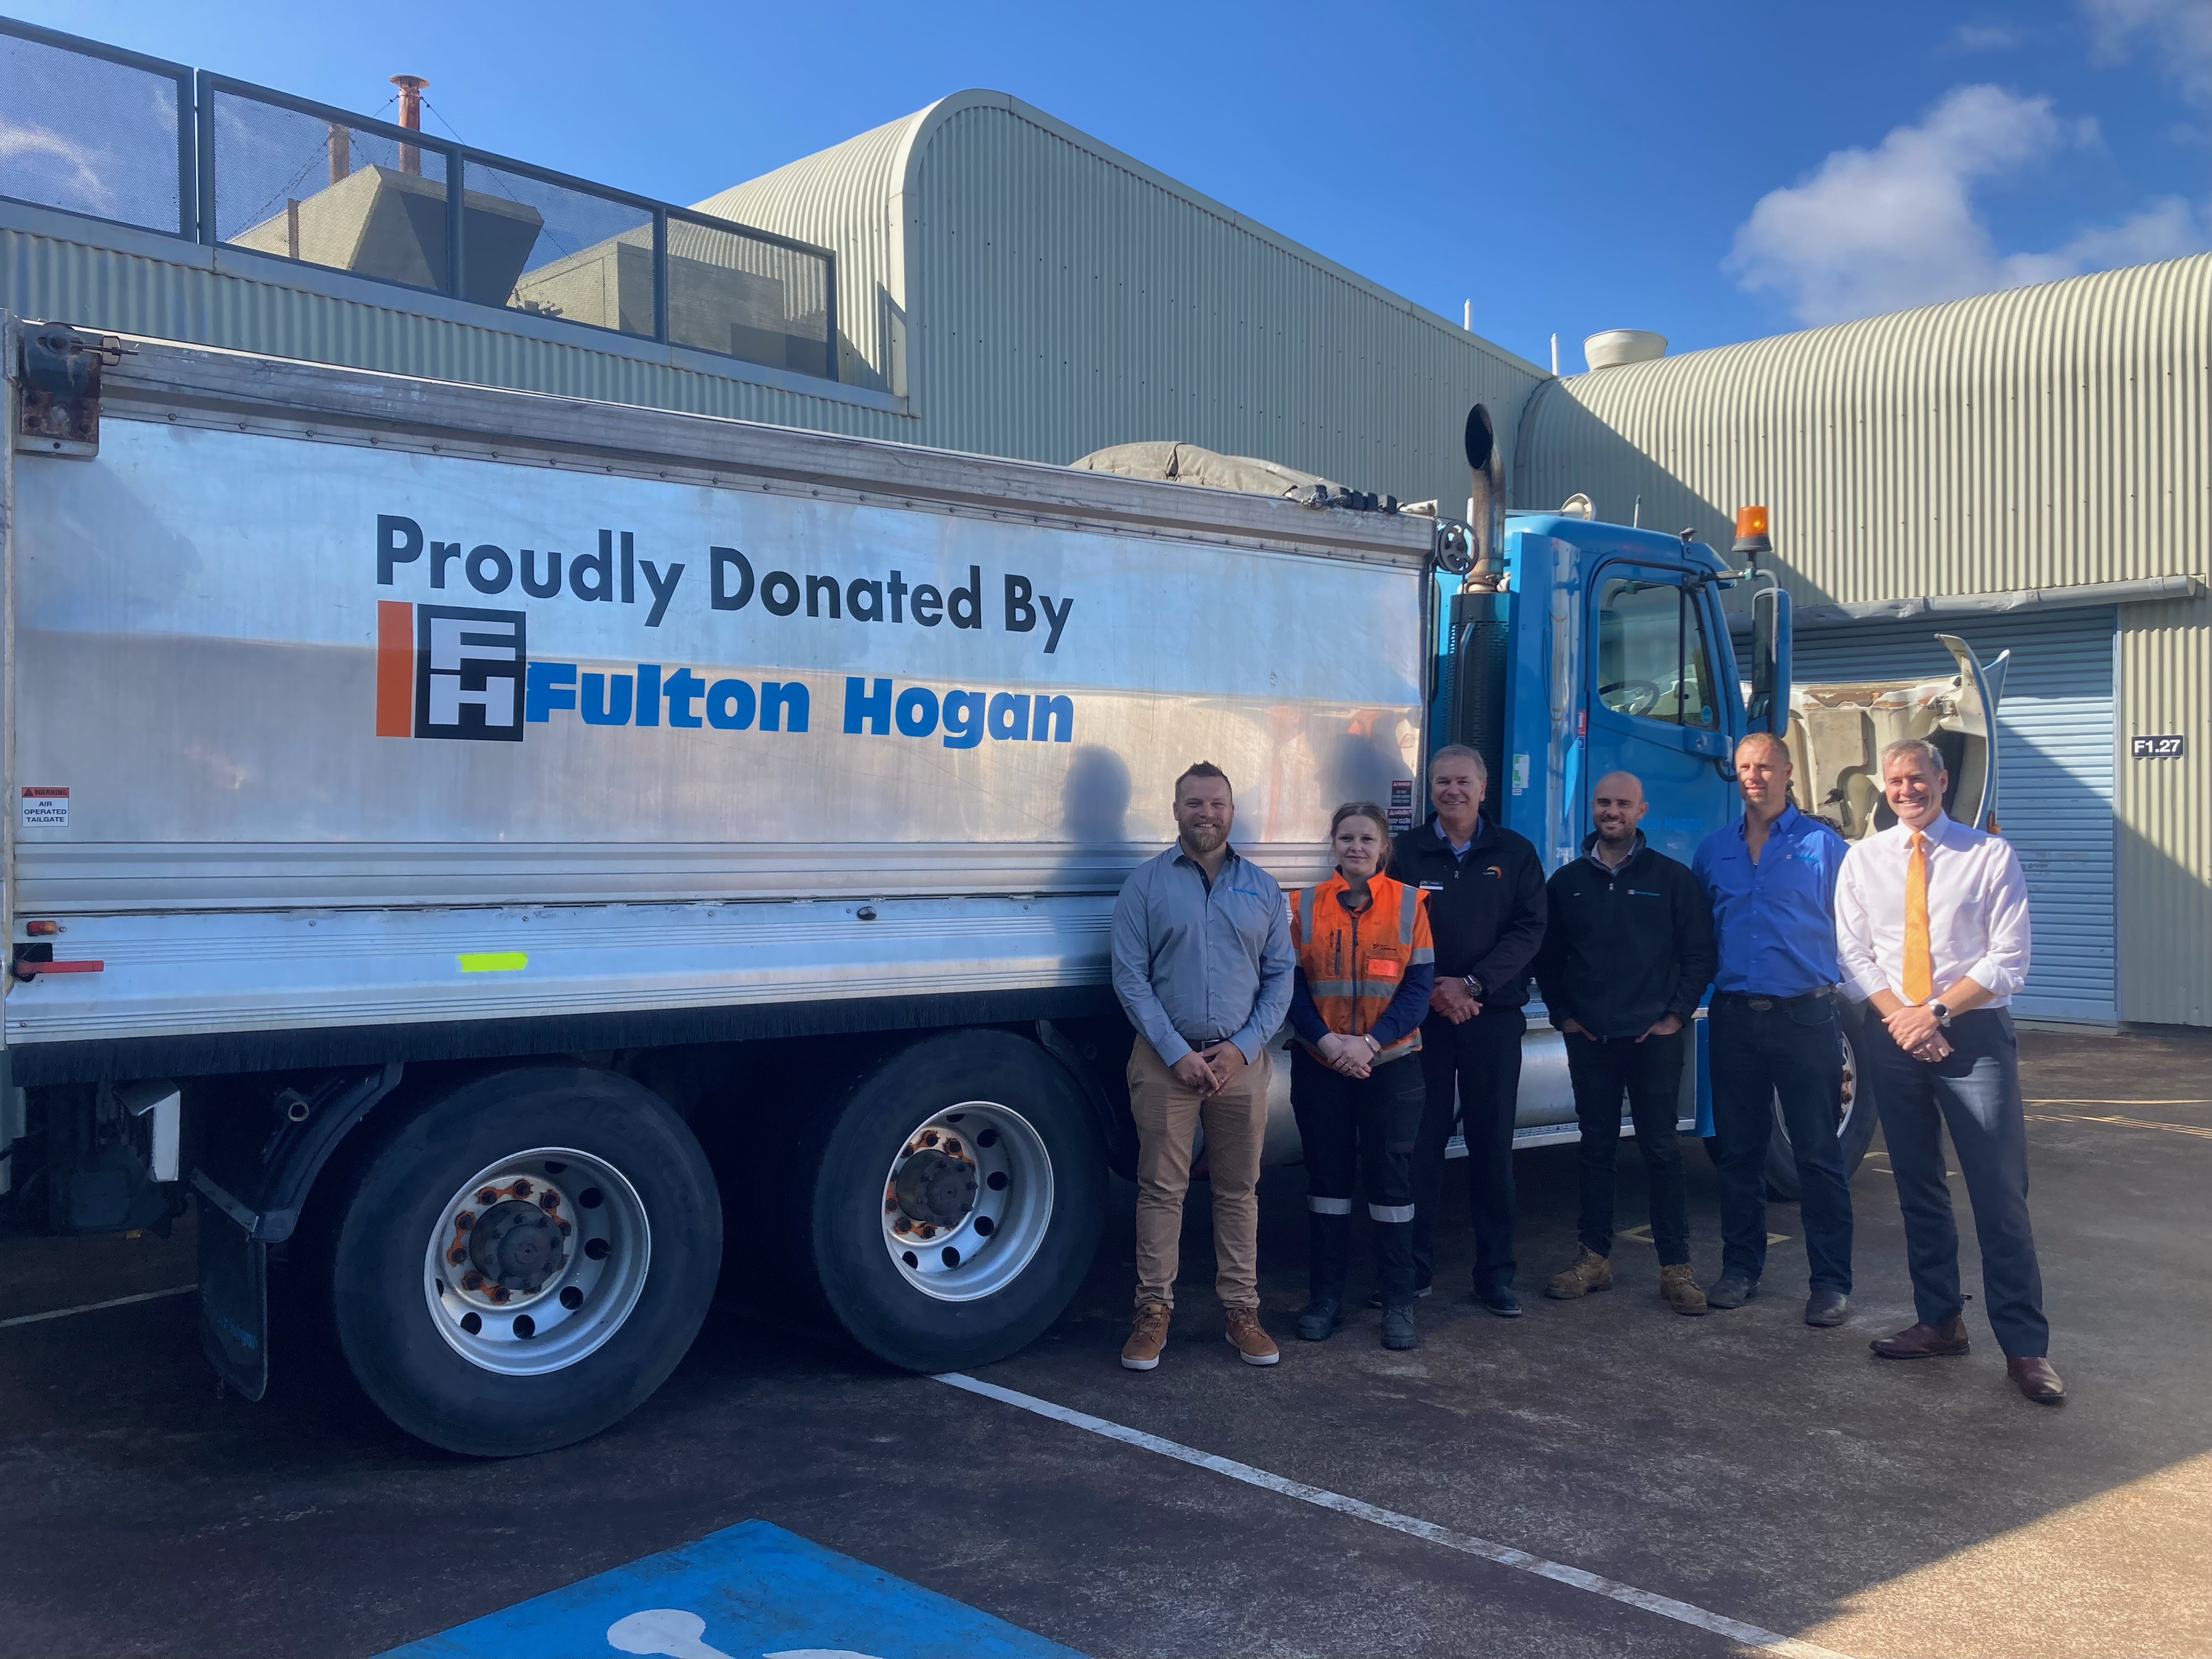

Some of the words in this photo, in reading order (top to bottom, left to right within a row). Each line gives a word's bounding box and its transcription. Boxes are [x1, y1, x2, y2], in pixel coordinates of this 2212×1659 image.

[377, 514, 685, 627] Proudly
[710, 546, 981, 629] Donated
[1005, 574, 1074, 653] By
[526, 662, 810, 732] Fulton
[843, 676, 1074, 749] Hogan
[2134, 740, 2181, 753] F1.27
